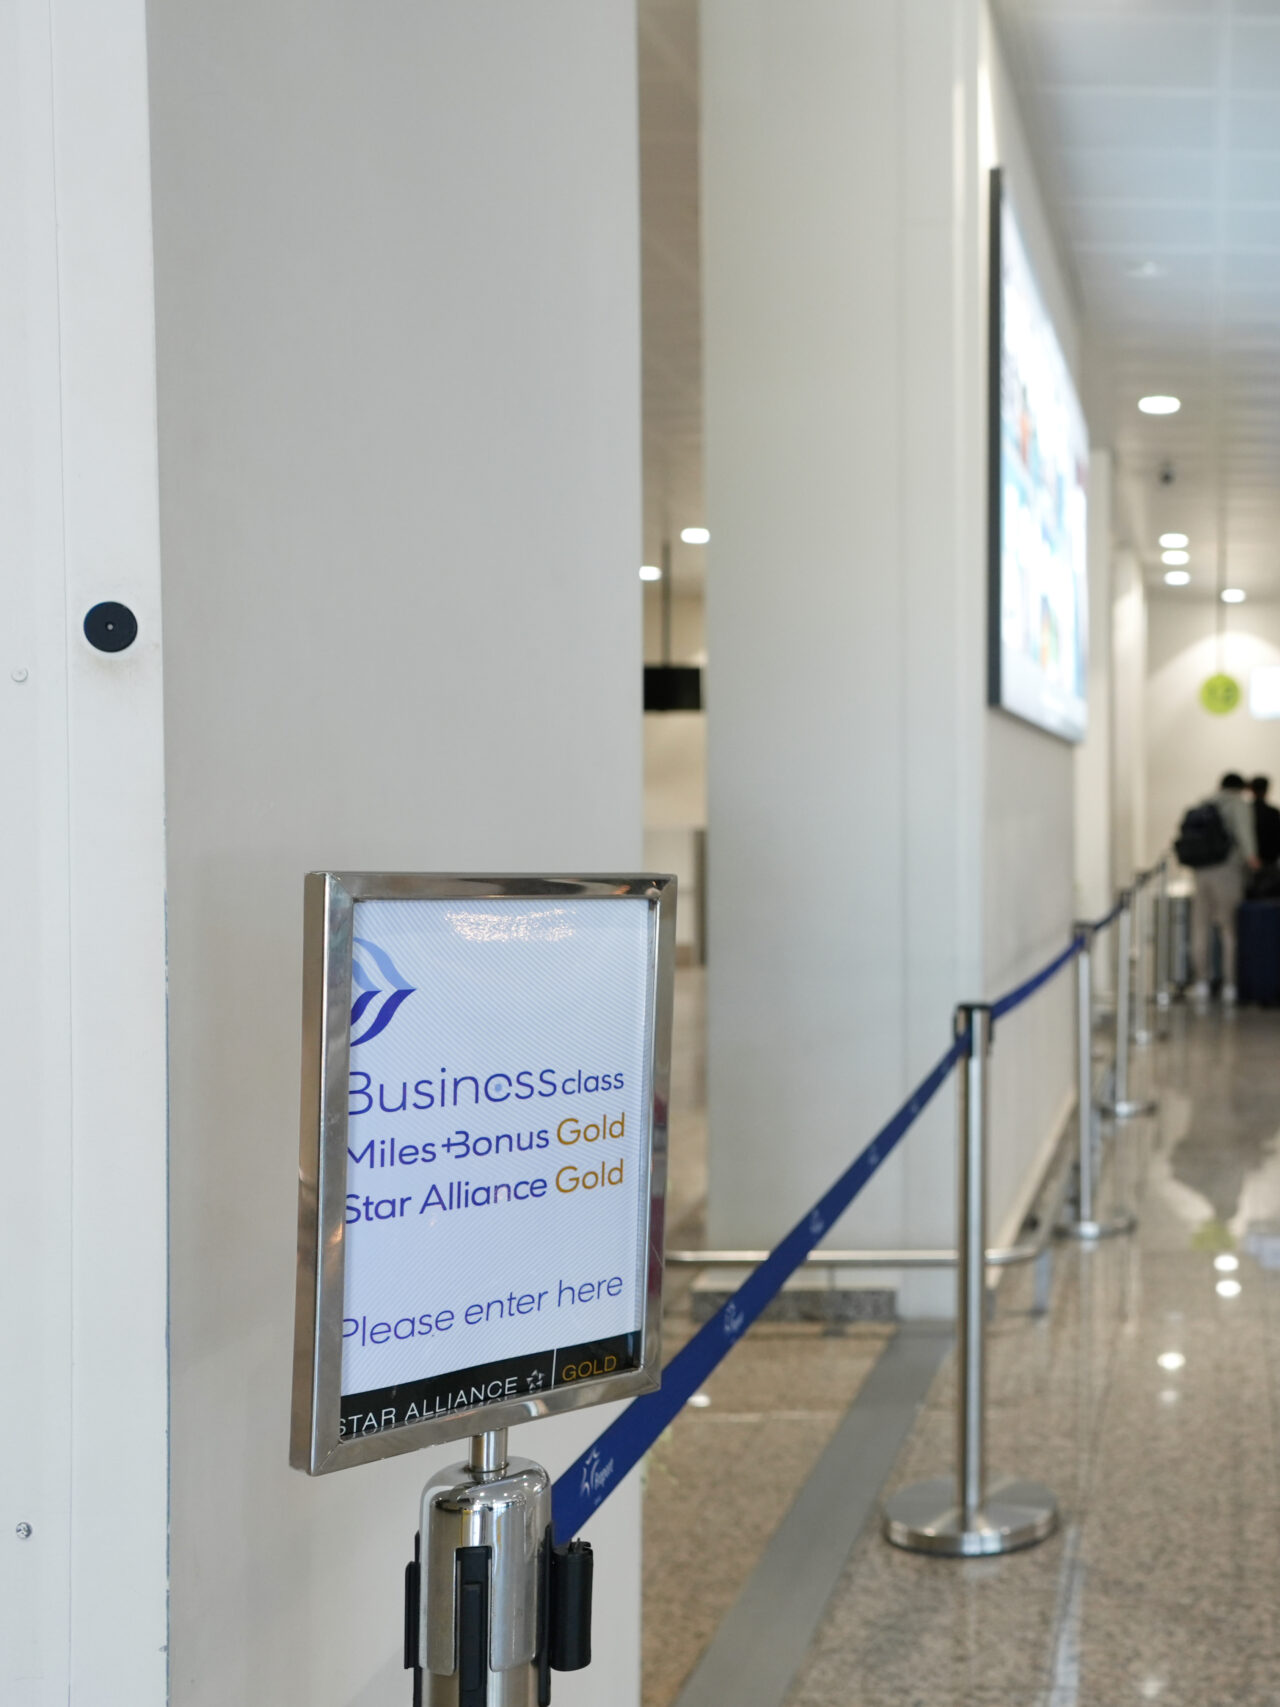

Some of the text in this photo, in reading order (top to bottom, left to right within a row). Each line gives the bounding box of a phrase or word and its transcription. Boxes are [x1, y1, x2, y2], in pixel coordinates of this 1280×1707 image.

[348, 1067, 625, 1116] Business class
[556, 1111, 625, 1145] Gold
[345, 1158, 624, 1224] Star Alliance Gold
[342, 1276, 623, 1346] Please enter here
[405, 1376, 518, 1421] ALLIANCE
[562, 1355, 617, 1381] GOLD
